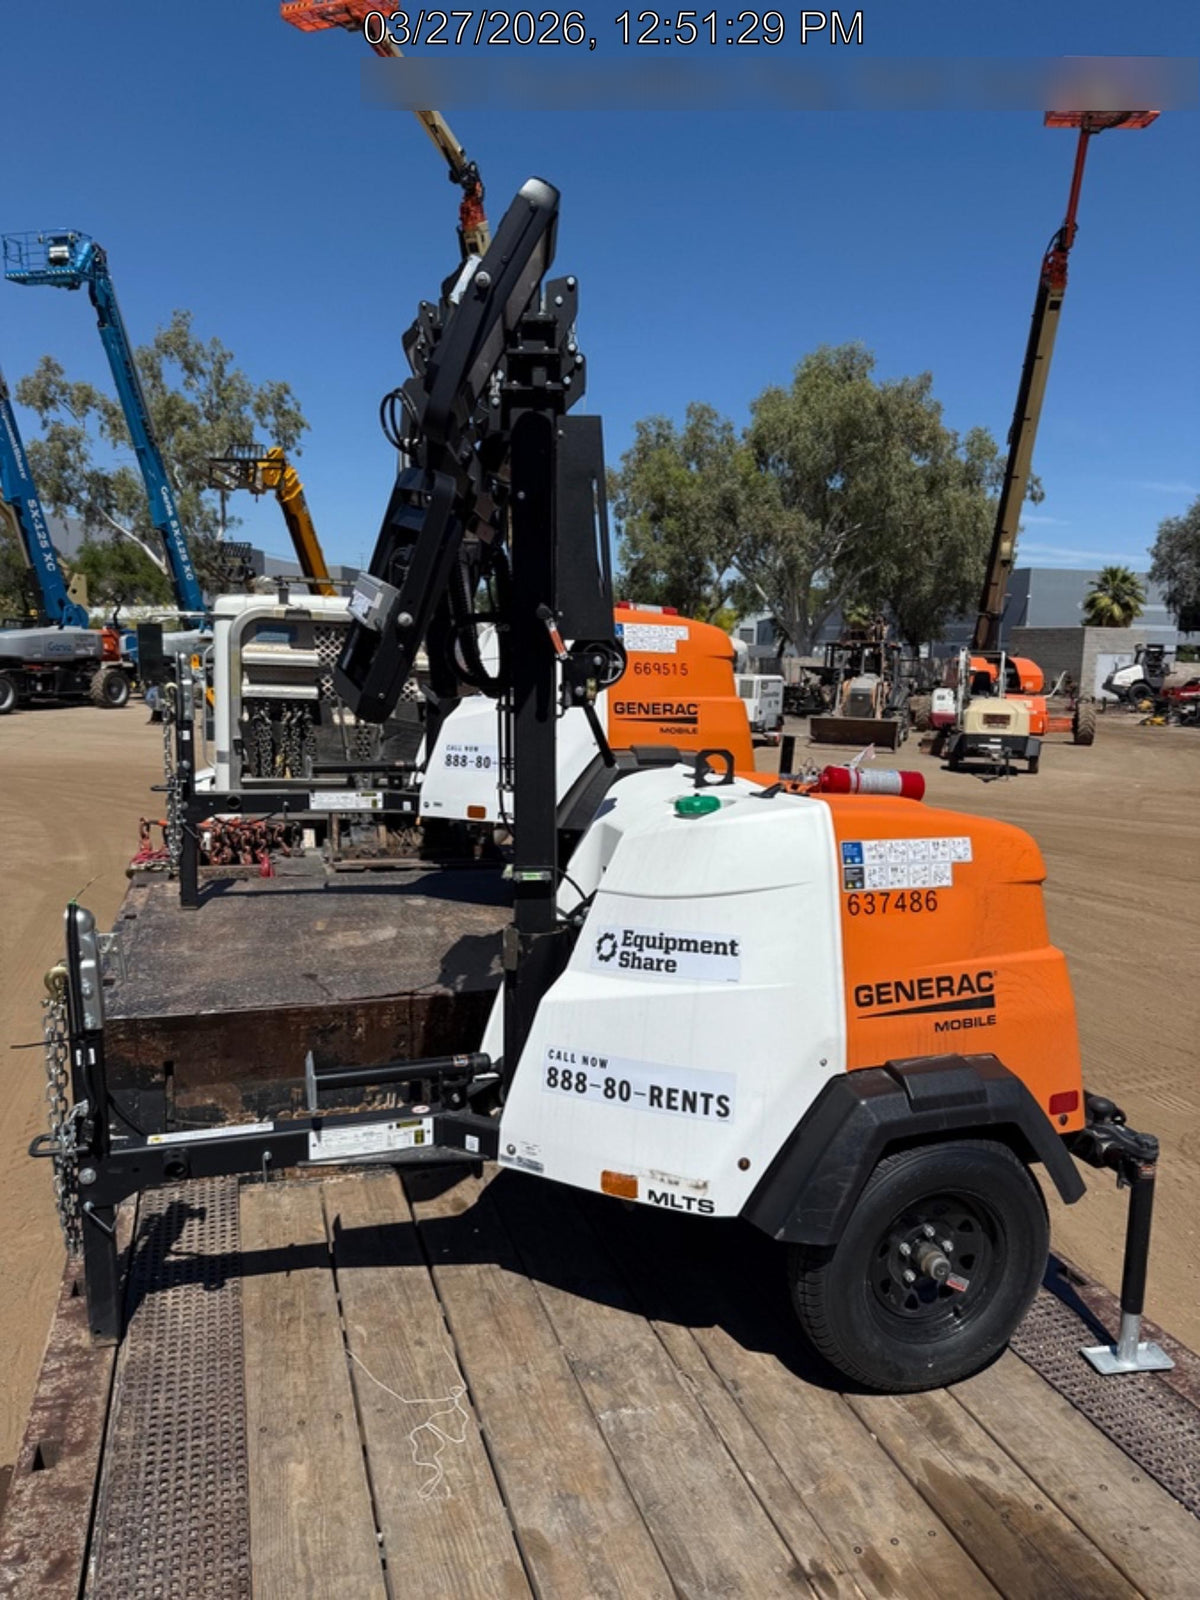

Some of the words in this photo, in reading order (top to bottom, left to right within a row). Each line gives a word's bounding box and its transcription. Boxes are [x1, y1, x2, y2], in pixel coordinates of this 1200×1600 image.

[28, 499, 50, 548] SX-125
[43, 552, 56, 573] XC
[634, 662, 688, 676] 669515
[613, 702, 698, 715] GENERAC
[659, 727, 698, 735] MOBILE
[847, 890, 938, 916] 637486
[621, 929, 739, 957] Equipment
[618, 950, 677, 973] Share
[854, 971, 995, 1008] GENERAC
[934, 1015, 997, 1032] MOBILE
[548, 1049, 576, 1064] CALL
[582, 1055, 609, 1069] NOW
[546, 1066, 731, 1118] 888-80-RENTS
[647, 1188, 715, 1215] MLTS
